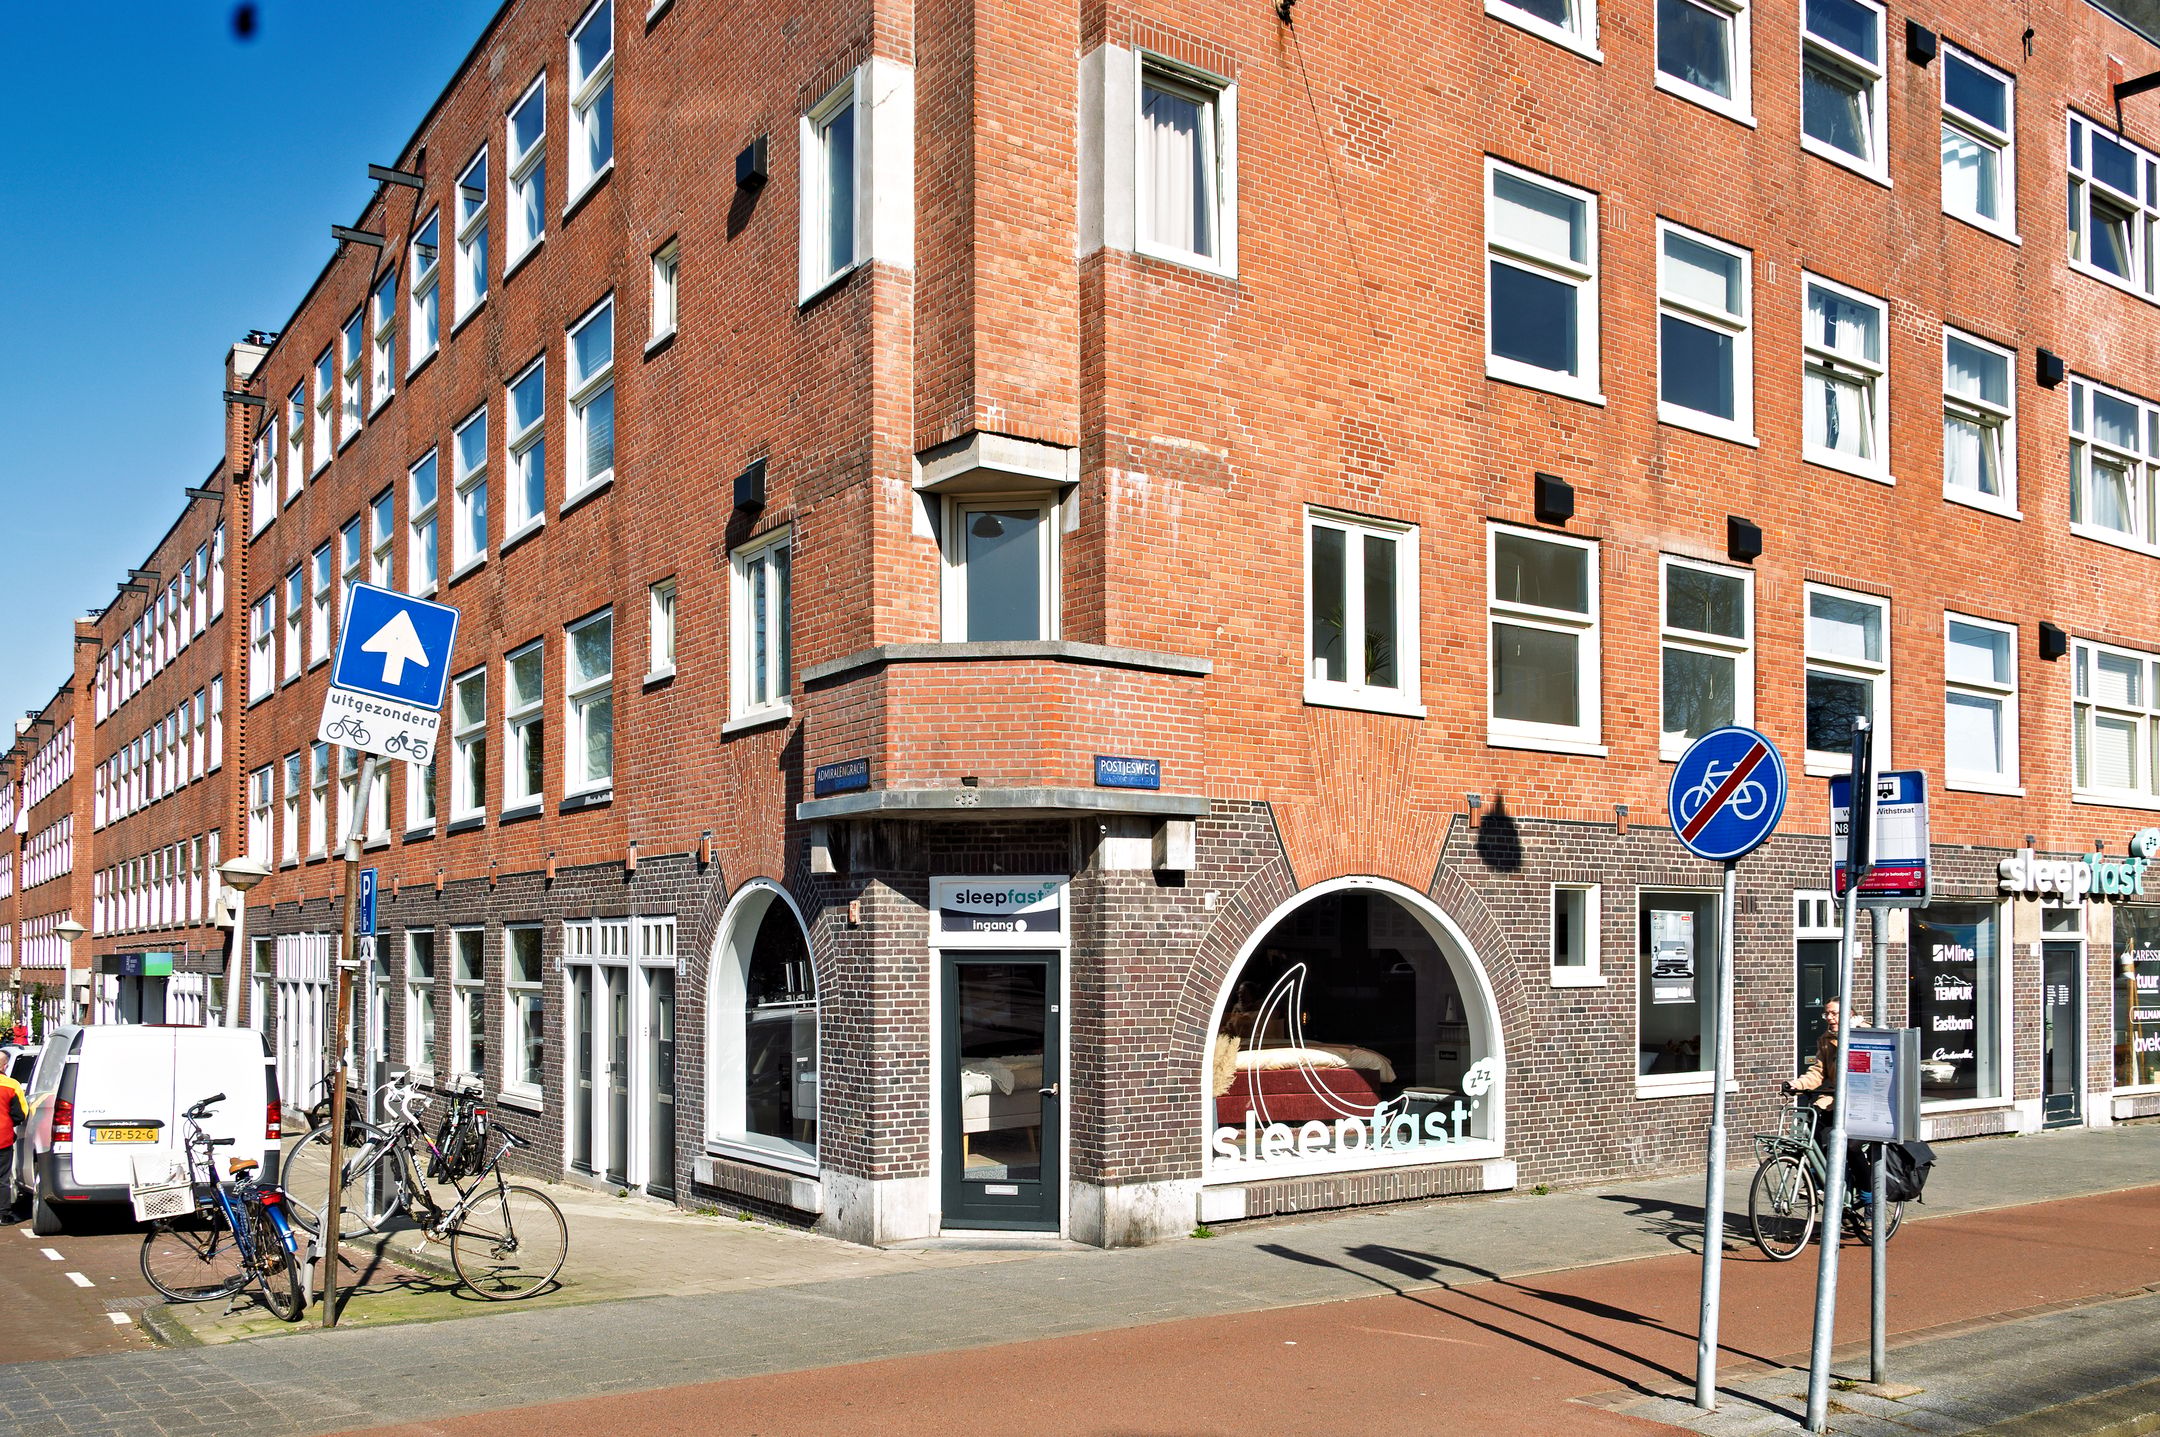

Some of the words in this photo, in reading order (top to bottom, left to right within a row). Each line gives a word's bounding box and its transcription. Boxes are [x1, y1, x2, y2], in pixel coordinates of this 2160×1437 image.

[331, 693, 437, 730] uitgezonderd
[817, 761, 867, 782] ADMIRALENGRACHT
[1100, 759, 1156, 776] POSTJESWEG
[2000, 848, 2144, 902] sleepfast
[363, 876, 371, 907] P
[955, 889, 1044, 907] sleepfast
[972, 919, 1014, 933] ingang
[2135, 973, 2159, 989] tuur
[1934, 986, 1973, 1001] TEMPUR
[1933, 1015, 1974, 1032] Eastborn
[100, 1130, 154, 1140] VZB-52-G
[1211, 1099, 1469, 1168] sleepfast
